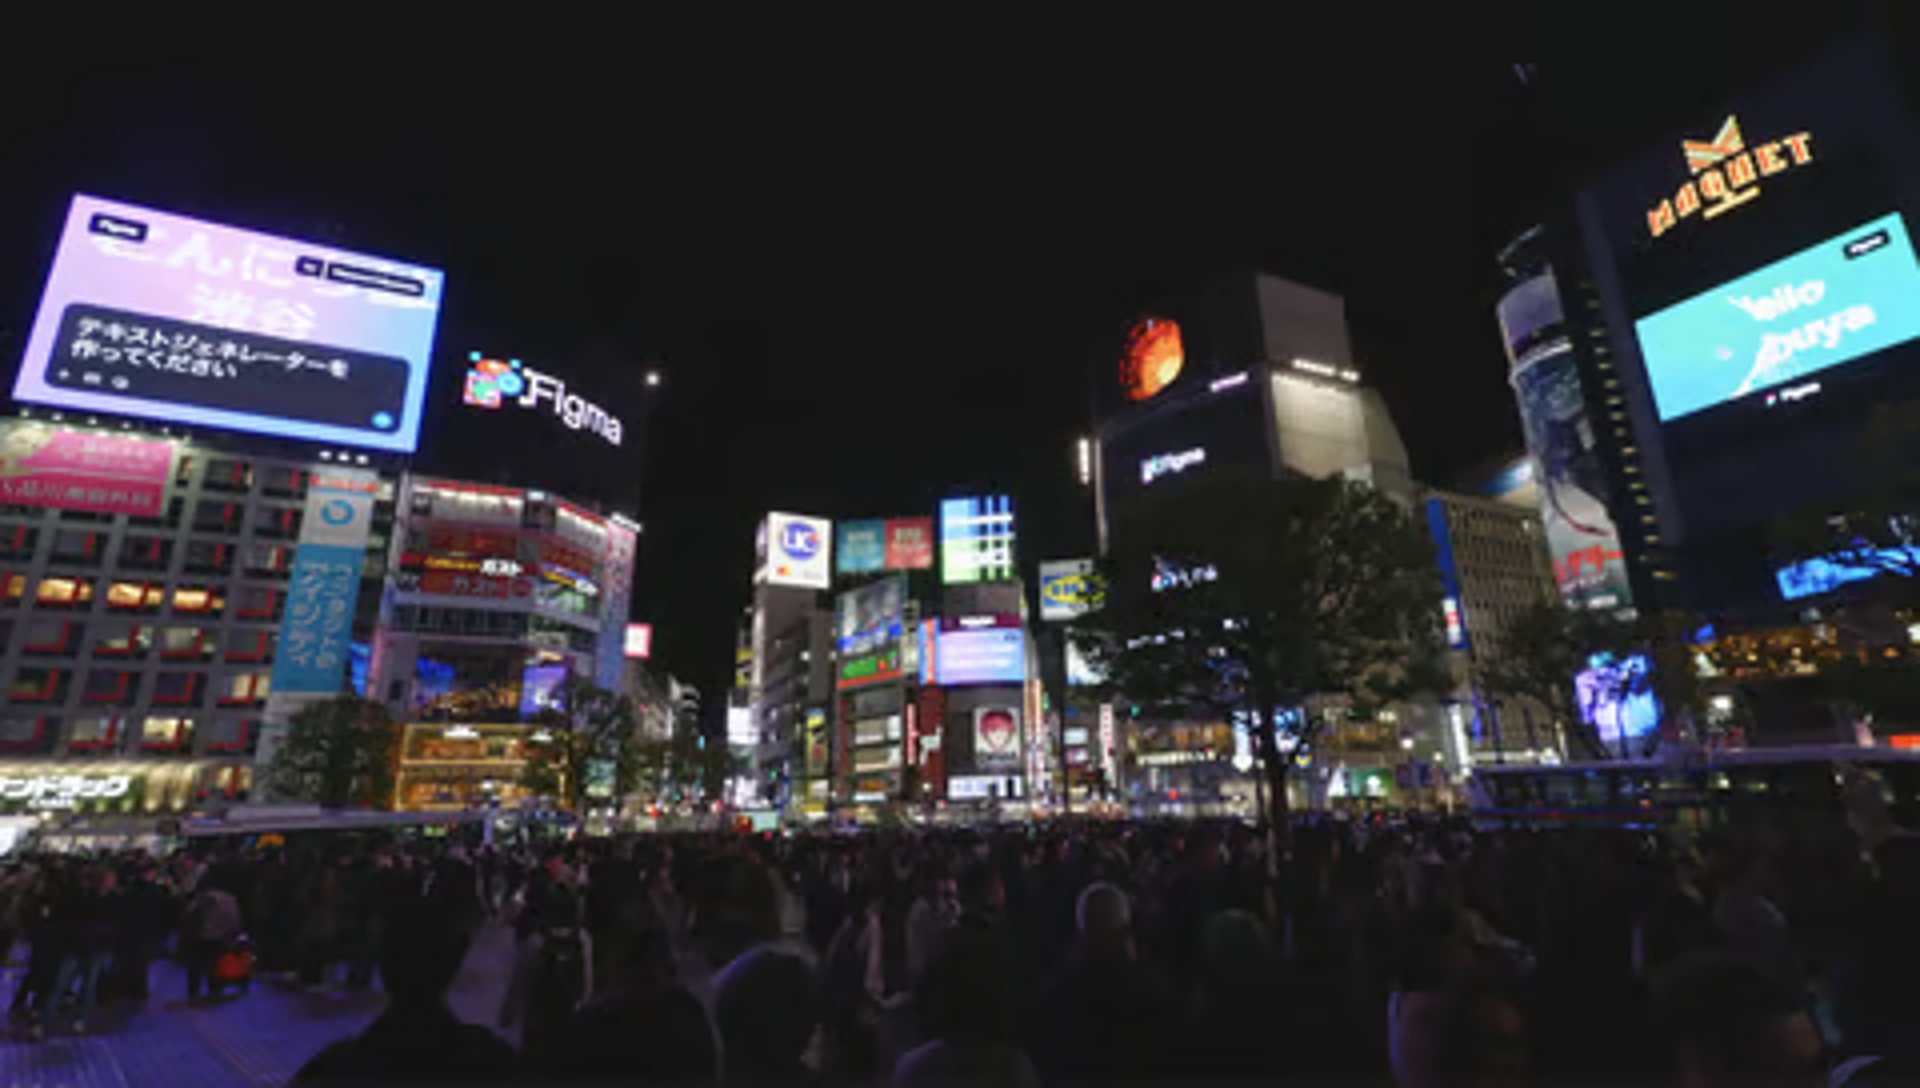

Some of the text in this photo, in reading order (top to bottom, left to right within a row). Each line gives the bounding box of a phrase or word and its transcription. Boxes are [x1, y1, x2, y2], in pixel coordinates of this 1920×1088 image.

[70, 338, 238, 378] 作ってください
[77, 316, 349, 380] テキストジェネレーターを
[519, 366, 623, 445] Figma
